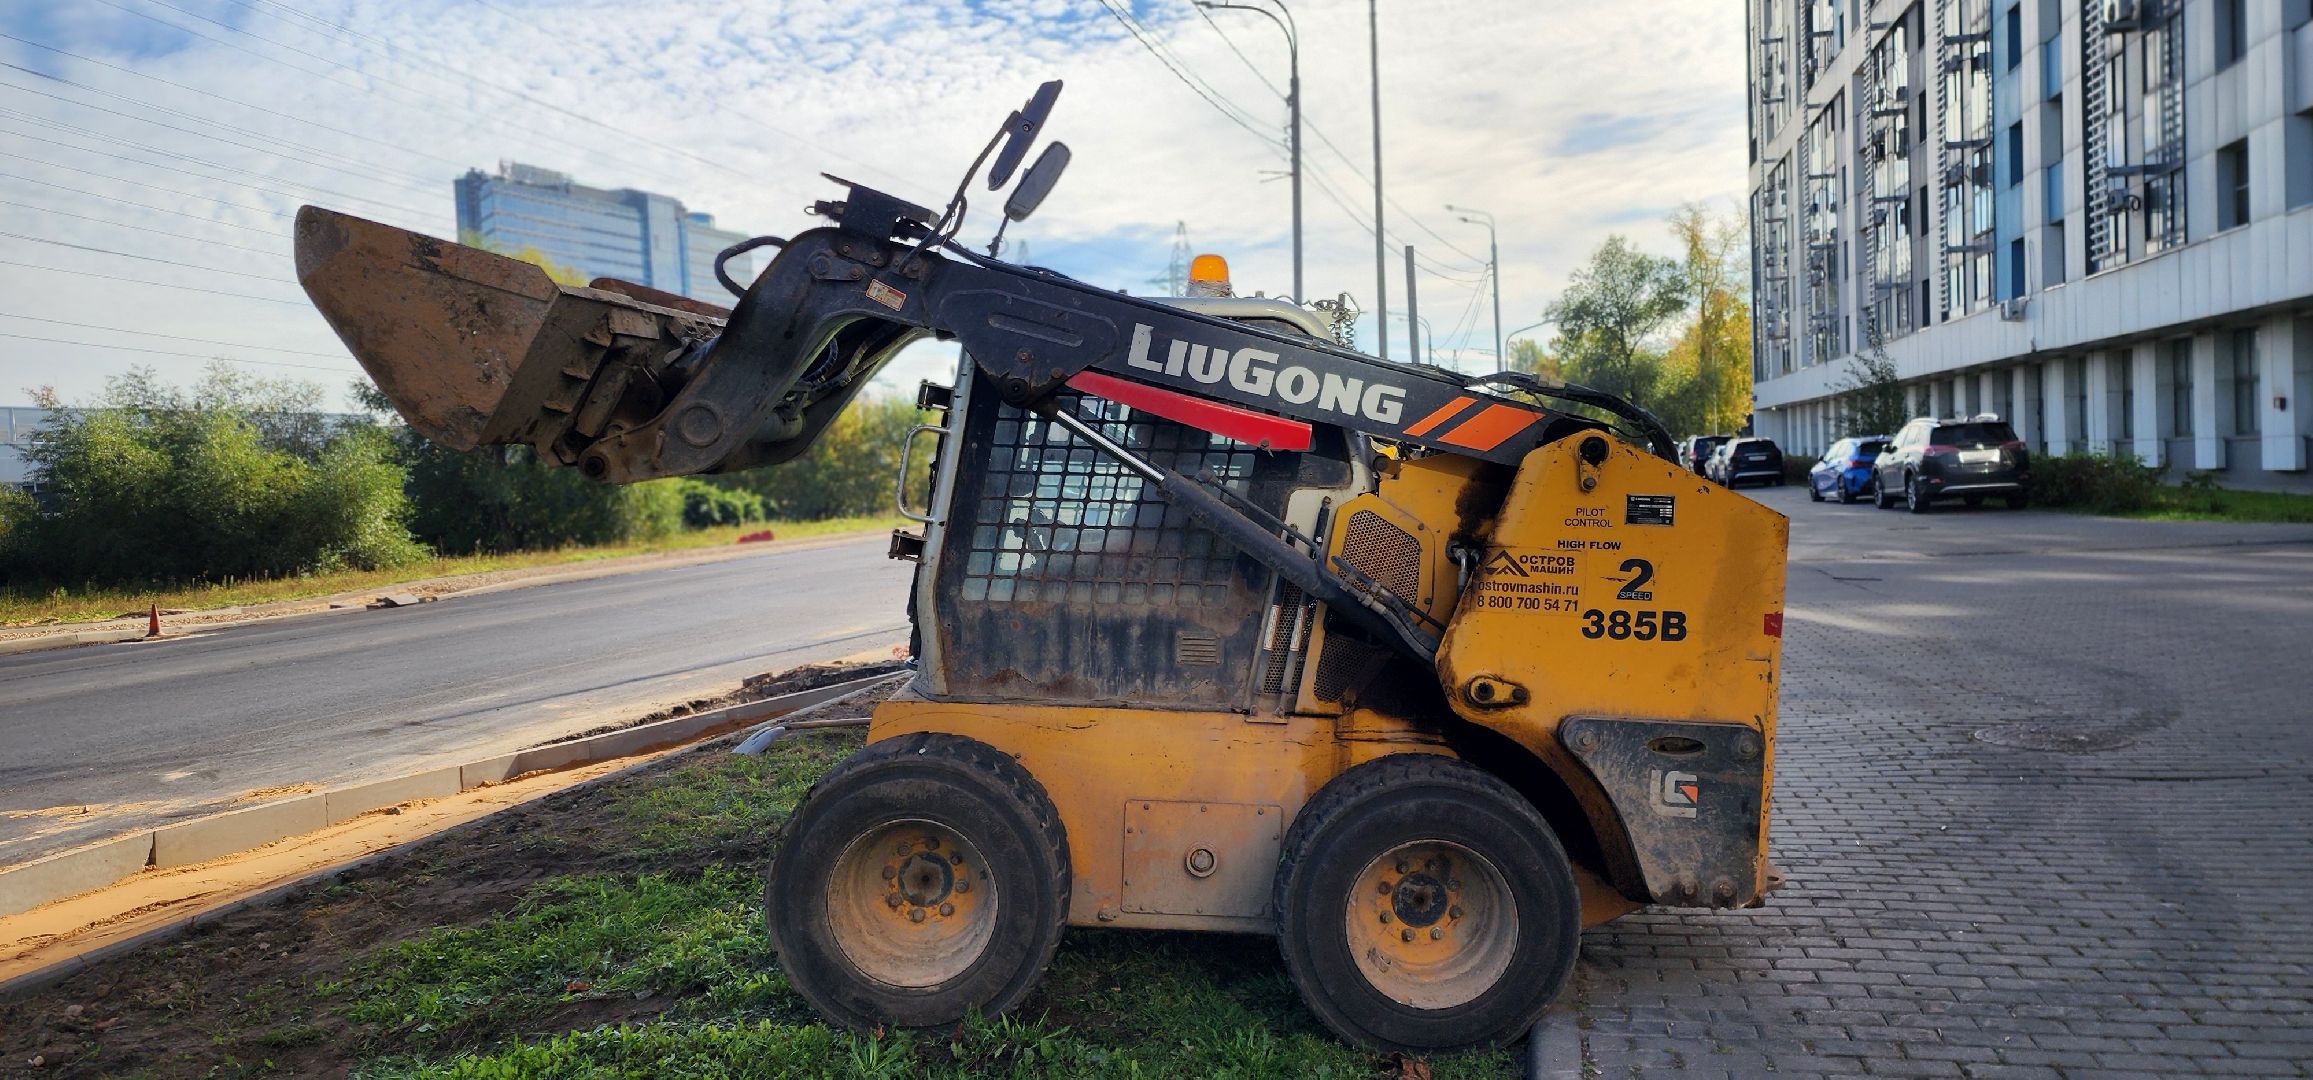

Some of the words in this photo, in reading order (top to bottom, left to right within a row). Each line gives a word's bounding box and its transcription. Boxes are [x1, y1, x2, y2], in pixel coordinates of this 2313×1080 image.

[1576, 507, 1606, 517] PILOT
[1564, 518, 1613, 528] CONTROL
[1557, 539, 1586, 549] HIGH
[1589, 541, 1622, 551] FLOW
[1519, 554, 1576, 567] ОСТРОВ
[1530, 565, 1575, 575] МАШИН
[1616, 558, 1654, 601] 2
[1478, 580, 1579, 596] ostrovmashin.ru
[1619, 591, 1651, 600] SPEED
[1477, 595, 1485, 608] 8
[1488, 595, 1513, 609] 800
[1516, 596, 1541, 610] 700
[1544, 598, 1560, 611] 54
[1564, 599, 1579, 612] 71
[1581, 608, 1688, 642] 385B
